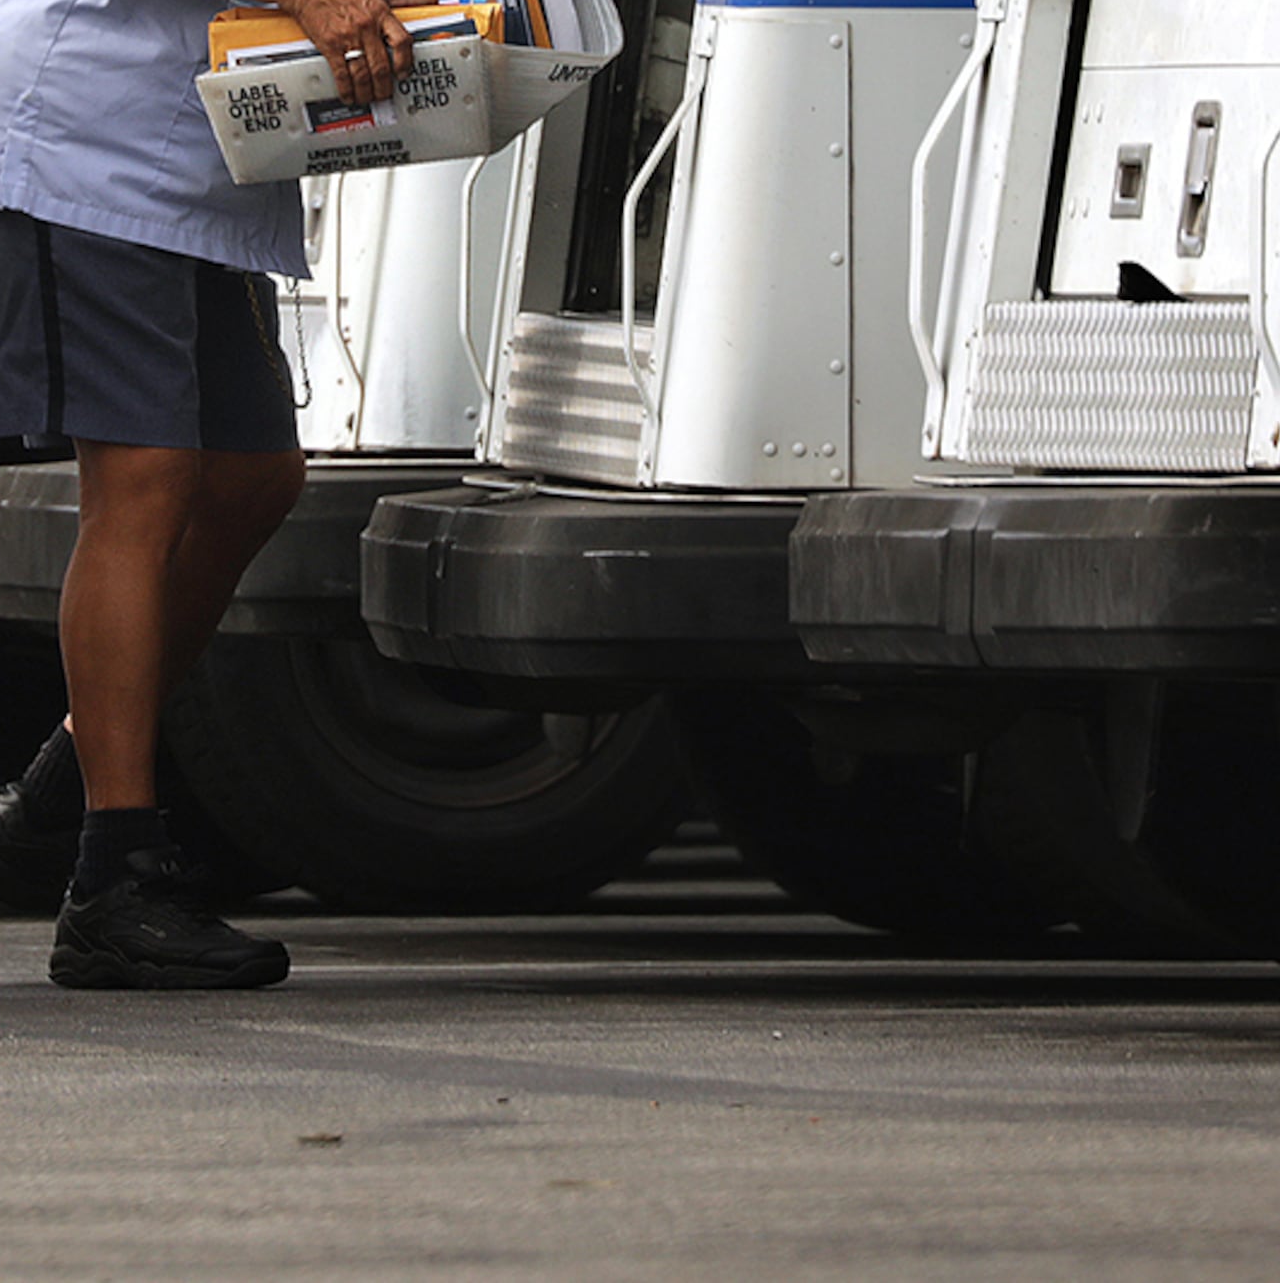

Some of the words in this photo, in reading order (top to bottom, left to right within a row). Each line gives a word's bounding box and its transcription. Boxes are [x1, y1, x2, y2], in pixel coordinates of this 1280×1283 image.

[407, 58, 454, 80] ABEL
[227, 83, 285, 103] LABEL
[398, 74, 459, 96] OTHER
[229, 99, 289, 120] OTHER
[413, 90, 450, 111] END
[244, 115, 282, 134] END
[308, 144, 353, 162] UNITED
[355, 139, 404, 157] STATES
[306, 158, 354, 175] POSTAL
[355, 151, 411, 168] SERVICE
